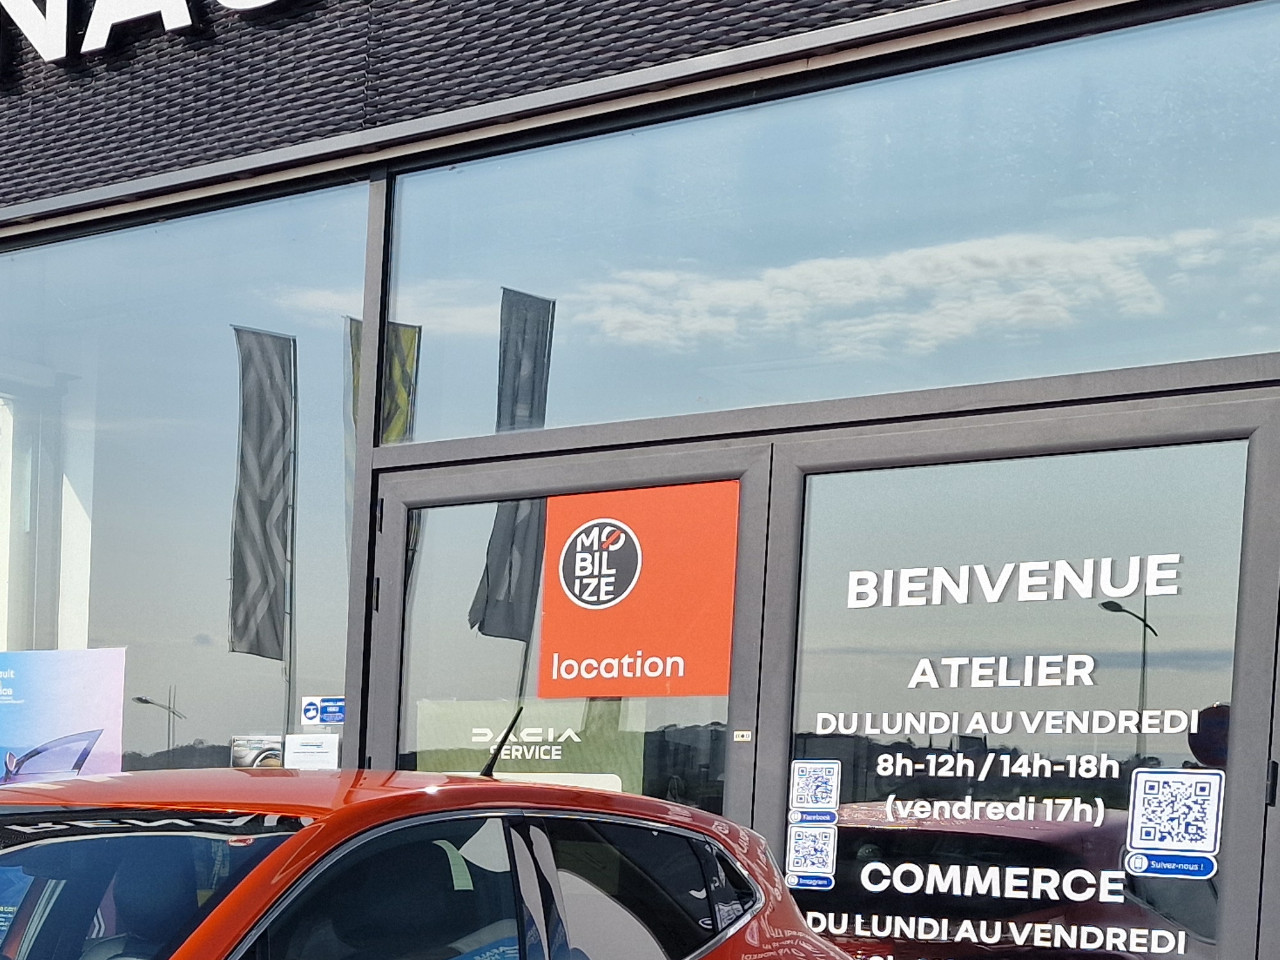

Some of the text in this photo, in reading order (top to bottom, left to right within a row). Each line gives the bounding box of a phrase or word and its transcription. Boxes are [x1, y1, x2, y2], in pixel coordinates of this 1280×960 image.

[846, 554, 1181, 609] BIENVENUE
[552, 650, 684, 680] location
[907, 654, 1096, 689] ATELIER
[816, 709, 1199, 735] DU LUNDI AU VENDREDI
[489, 744, 562, 760] SERVICE
[885, 794, 1105, 828] (vendredi 17h)
[860, 861, 1127, 904] COMMERCE
[1150, 861, 1199, 871] Suivez-nous
[806, 911, 1186, 955] DU LUNDI AU VENDREDI
